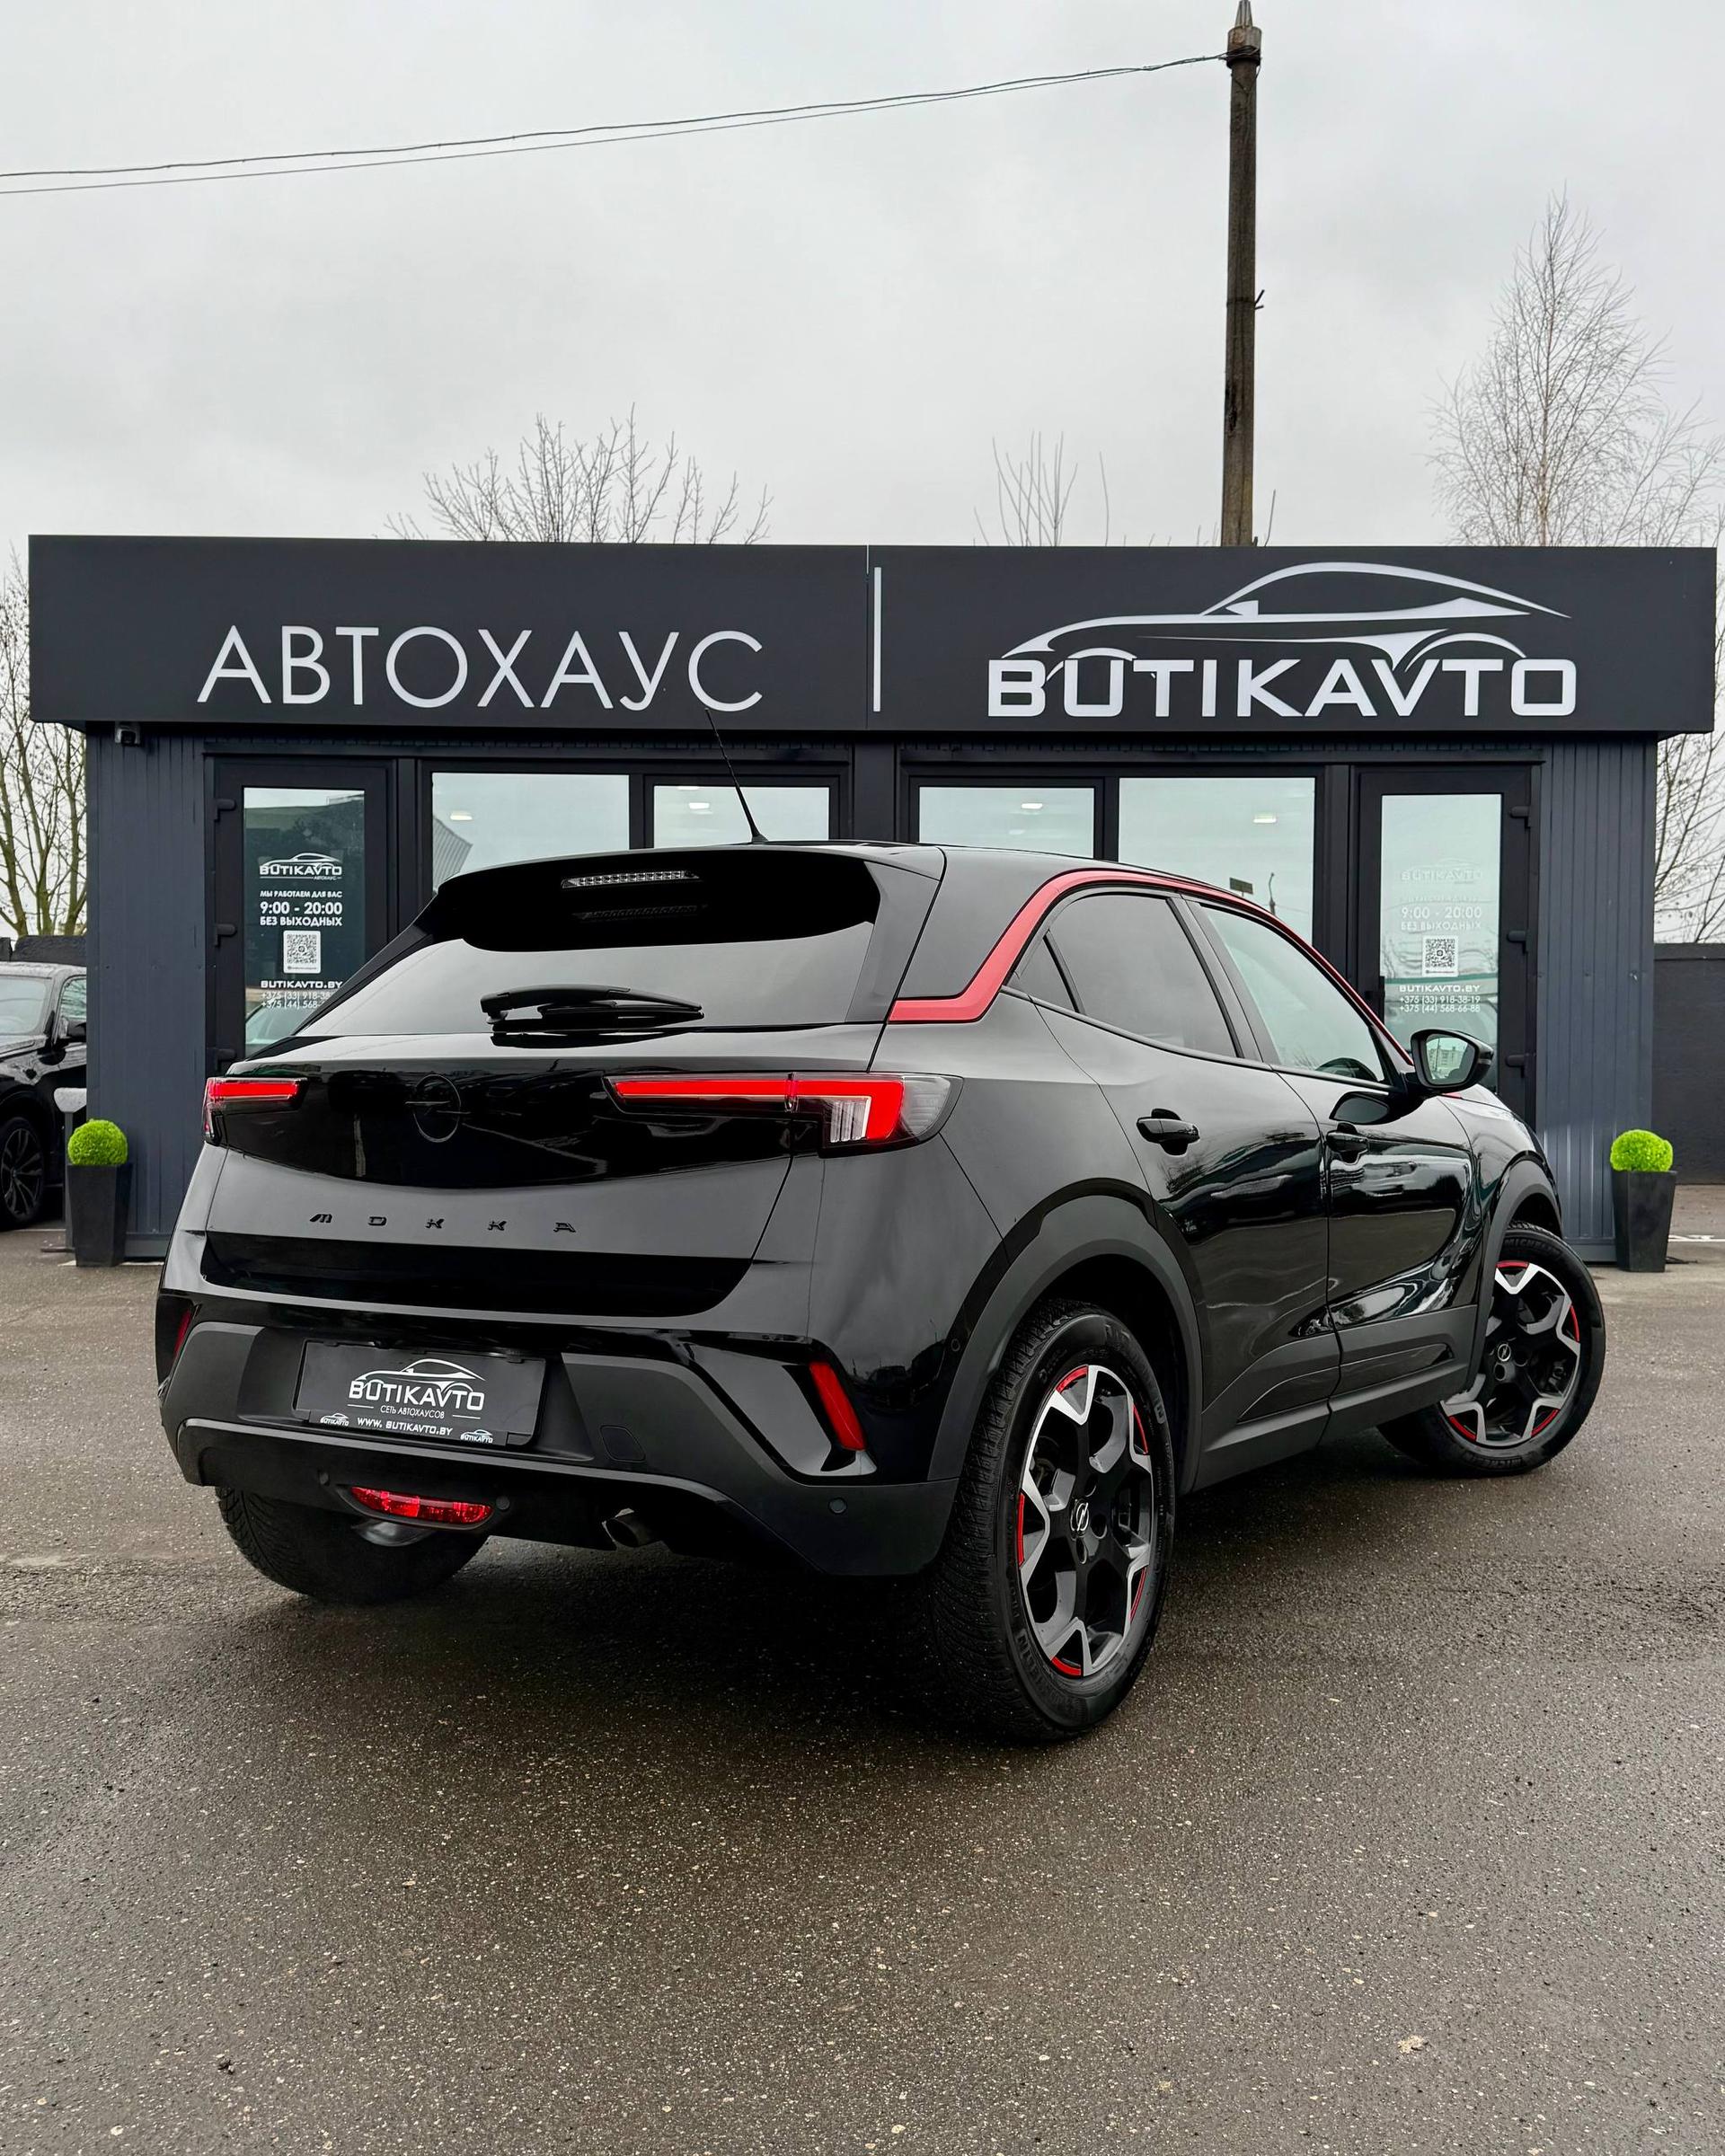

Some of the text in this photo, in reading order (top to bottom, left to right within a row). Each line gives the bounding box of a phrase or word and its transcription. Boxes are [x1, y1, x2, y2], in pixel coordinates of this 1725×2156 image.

[197, 624, 764, 712] АВТОХАУС
[987, 658, 1577, 718] BUTIKAVTO
[259, 865, 342, 876] BUTIKAVTO
[311, 890, 326, 898] ДЛЯ
[327, 890, 342, 898] ВАС
[260, 901, 290, 915] 9:00
[304, 901, 342, 915] 20:00
[1401, 906, 1430, 919] 9:00
[1444, 906, 1482, 919] 20:00
[260, 915, 342, 927] БЕЗ ВЫХОДНЫХ
[1401, 921, 1481, 931] БЕЗ ВЫХОДНЫХ
[261, 980, 343, 988] BUTIKAVTO.BY
[1399, 985, 1480, 993] BUTIKAVTO.BY
[262, 991, 282, 1000] +375
[284, 991, 300, 1001] (33)
[1400, 995, 1420, 1003] +375
[1421, 995, 1438, 1004] (33)
[262, 1000, 282, 1009] +375
[284, 1000, 300, 1010] (44)
[1400, 1004, 1420, 1012] +375
[1421, 1004, 1438, 1013] (44)
[348, 1380, 486, 1411] BUTIKAVTO
[380, 1405, 445, 1419] СЕТЬ АВТОХАУСОВ
[357, 1417, 454, 1436] WWW. BUTIKAVTO.BY
